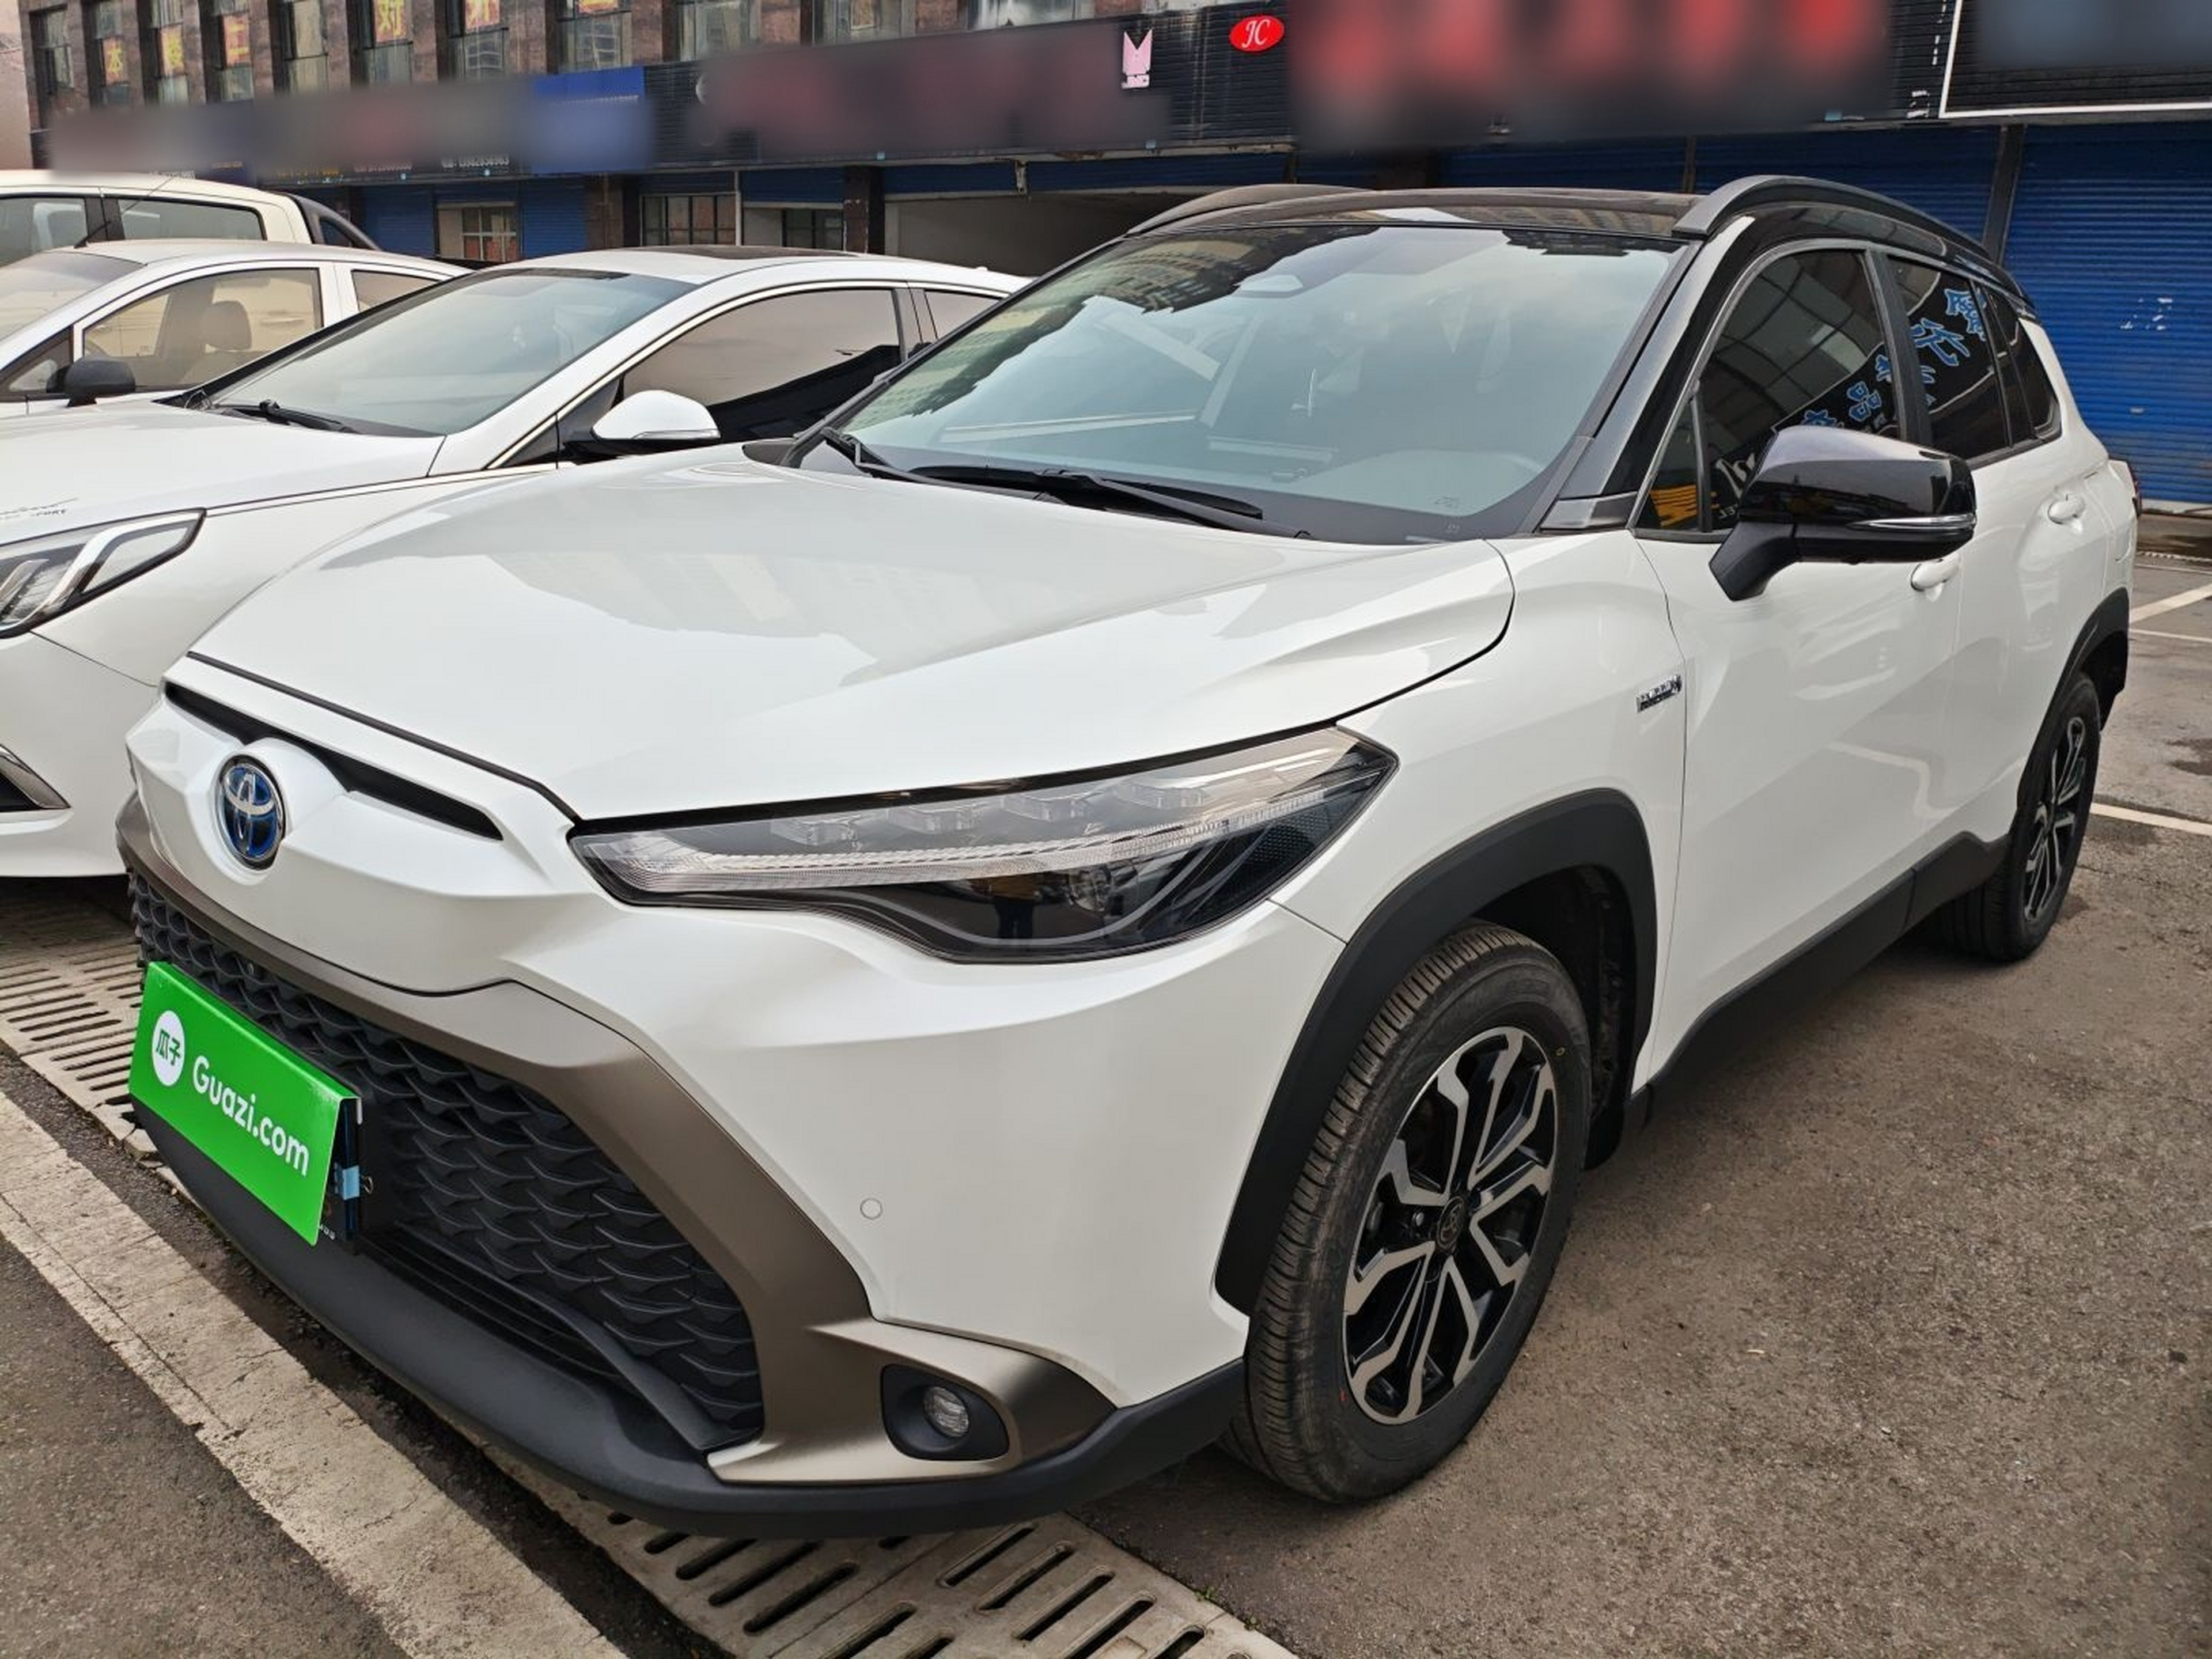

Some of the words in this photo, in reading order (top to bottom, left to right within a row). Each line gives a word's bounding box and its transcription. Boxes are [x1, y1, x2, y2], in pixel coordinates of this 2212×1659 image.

[1241, 19, 1271, 48] JC
[156, 1028, 181, 1066] 瓜子
[192, 1055, 310, 1177] Guazi.com
